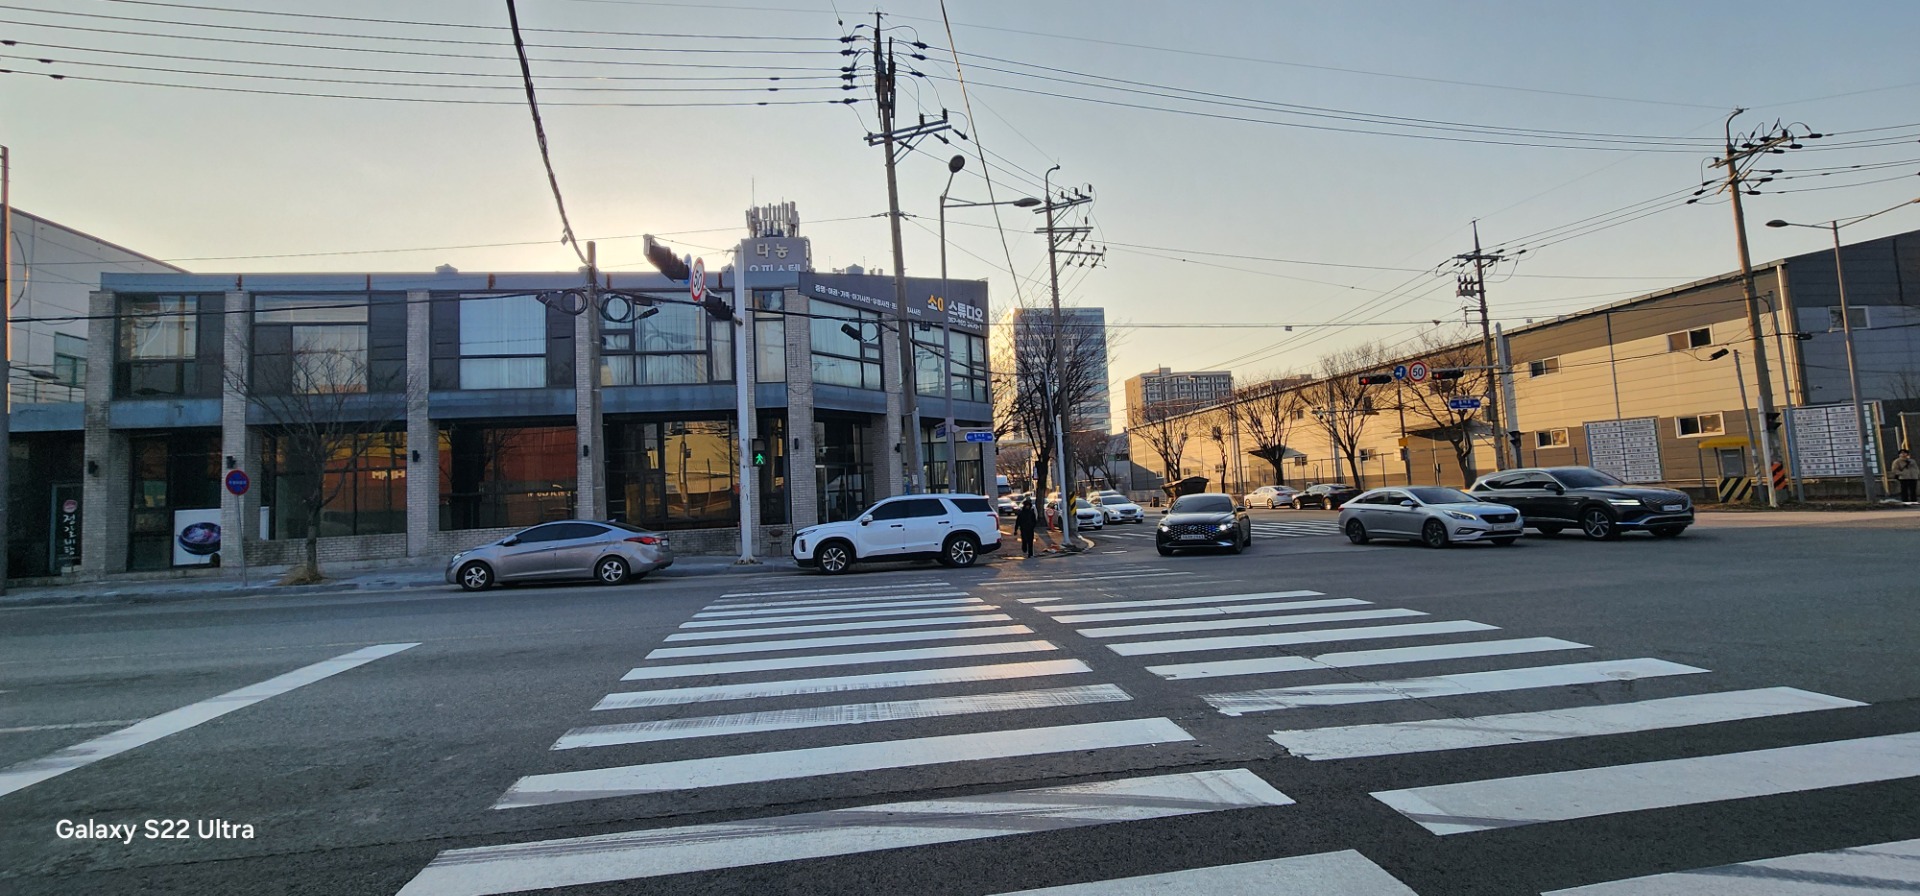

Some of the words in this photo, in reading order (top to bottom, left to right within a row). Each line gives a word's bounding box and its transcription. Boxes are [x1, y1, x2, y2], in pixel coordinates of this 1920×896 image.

[693, 269, 703, 292] 50
[947, 300, 984, 322] 스튜디오
[1412, 367, 1424, 377] 50
[63, 513, 77, 556] 정갈비탕
